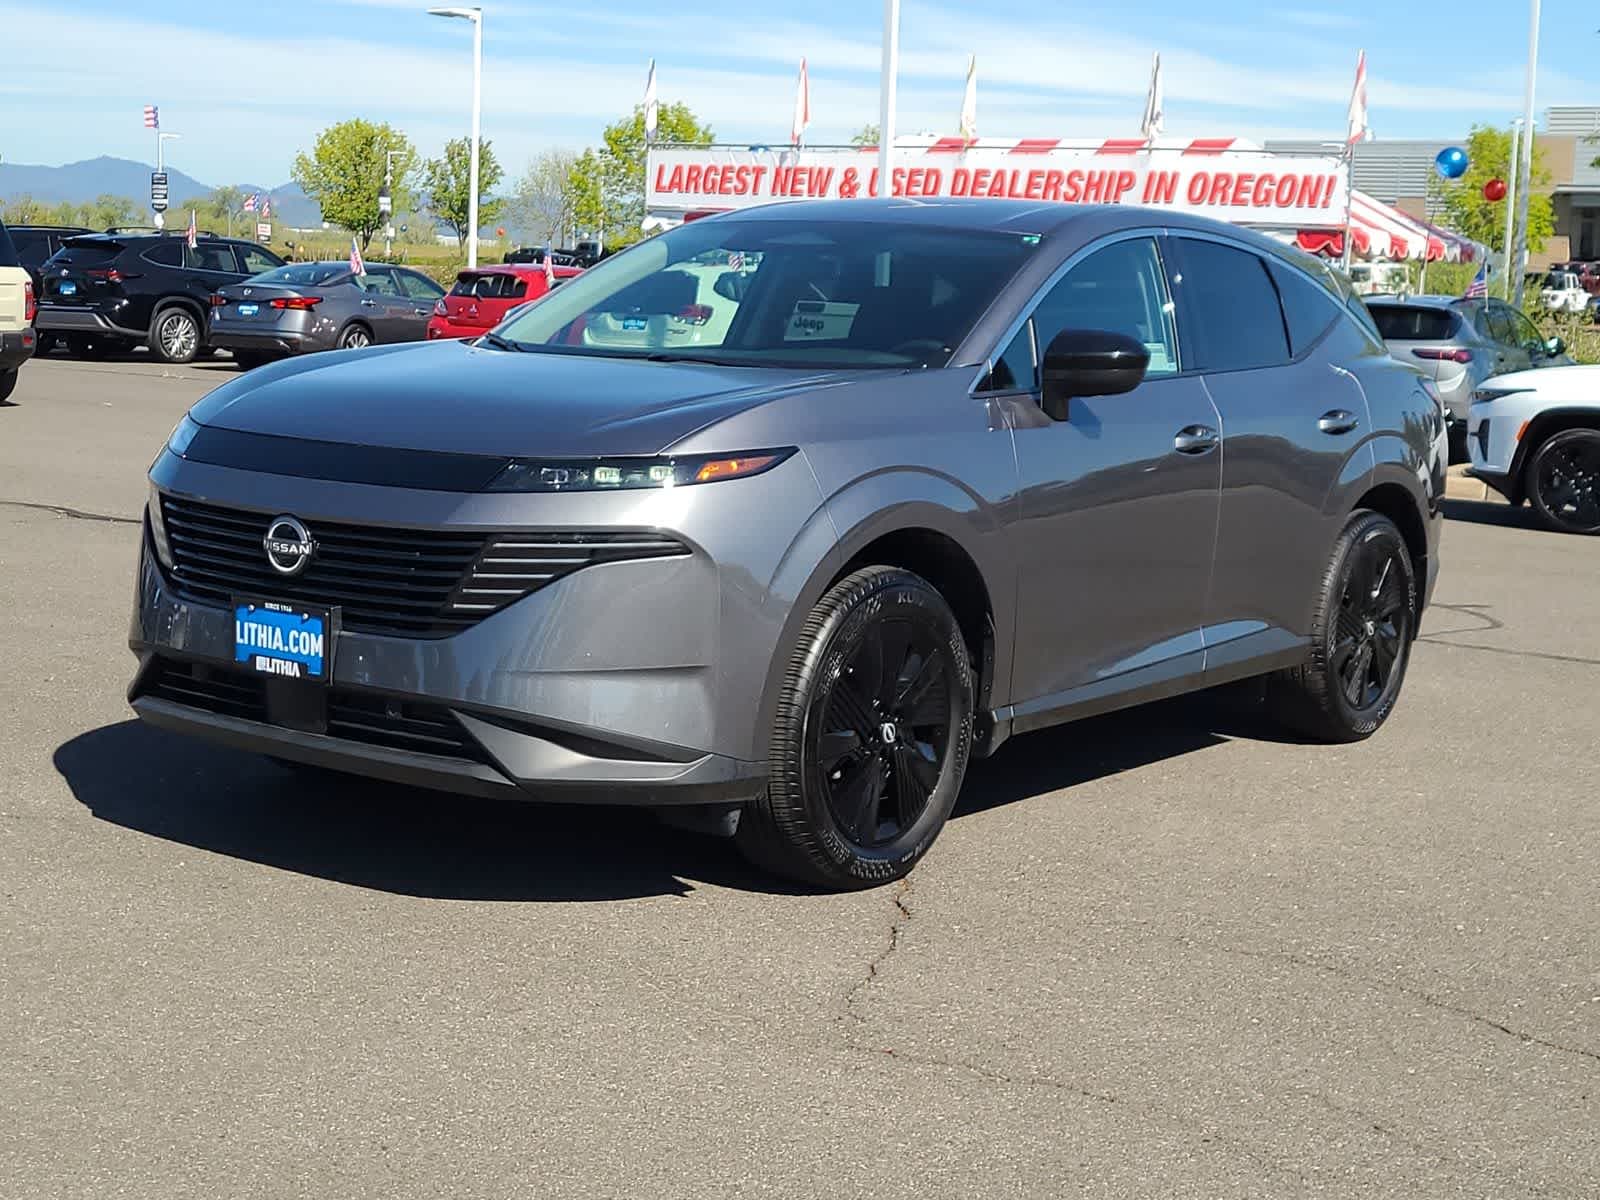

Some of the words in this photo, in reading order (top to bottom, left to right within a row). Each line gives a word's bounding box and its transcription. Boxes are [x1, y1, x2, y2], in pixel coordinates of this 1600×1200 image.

[655, 163, 768, 197] LARGEST
[771, 166, 835, 198] NEW
[839, 167, 861, 199] &
[950, 168, 1137, 204] DEALERSHIP
[1142, 171, 1180, 205] IN
[1187, 172, 1337, 210] OREGON!
[793, 315, 825, 332] Jeep
[263, 539, 310, 555] NISSAN
[236, 620, 324, 658] LITHIA.COM
[266, 657, 301, 678] LITHIA
